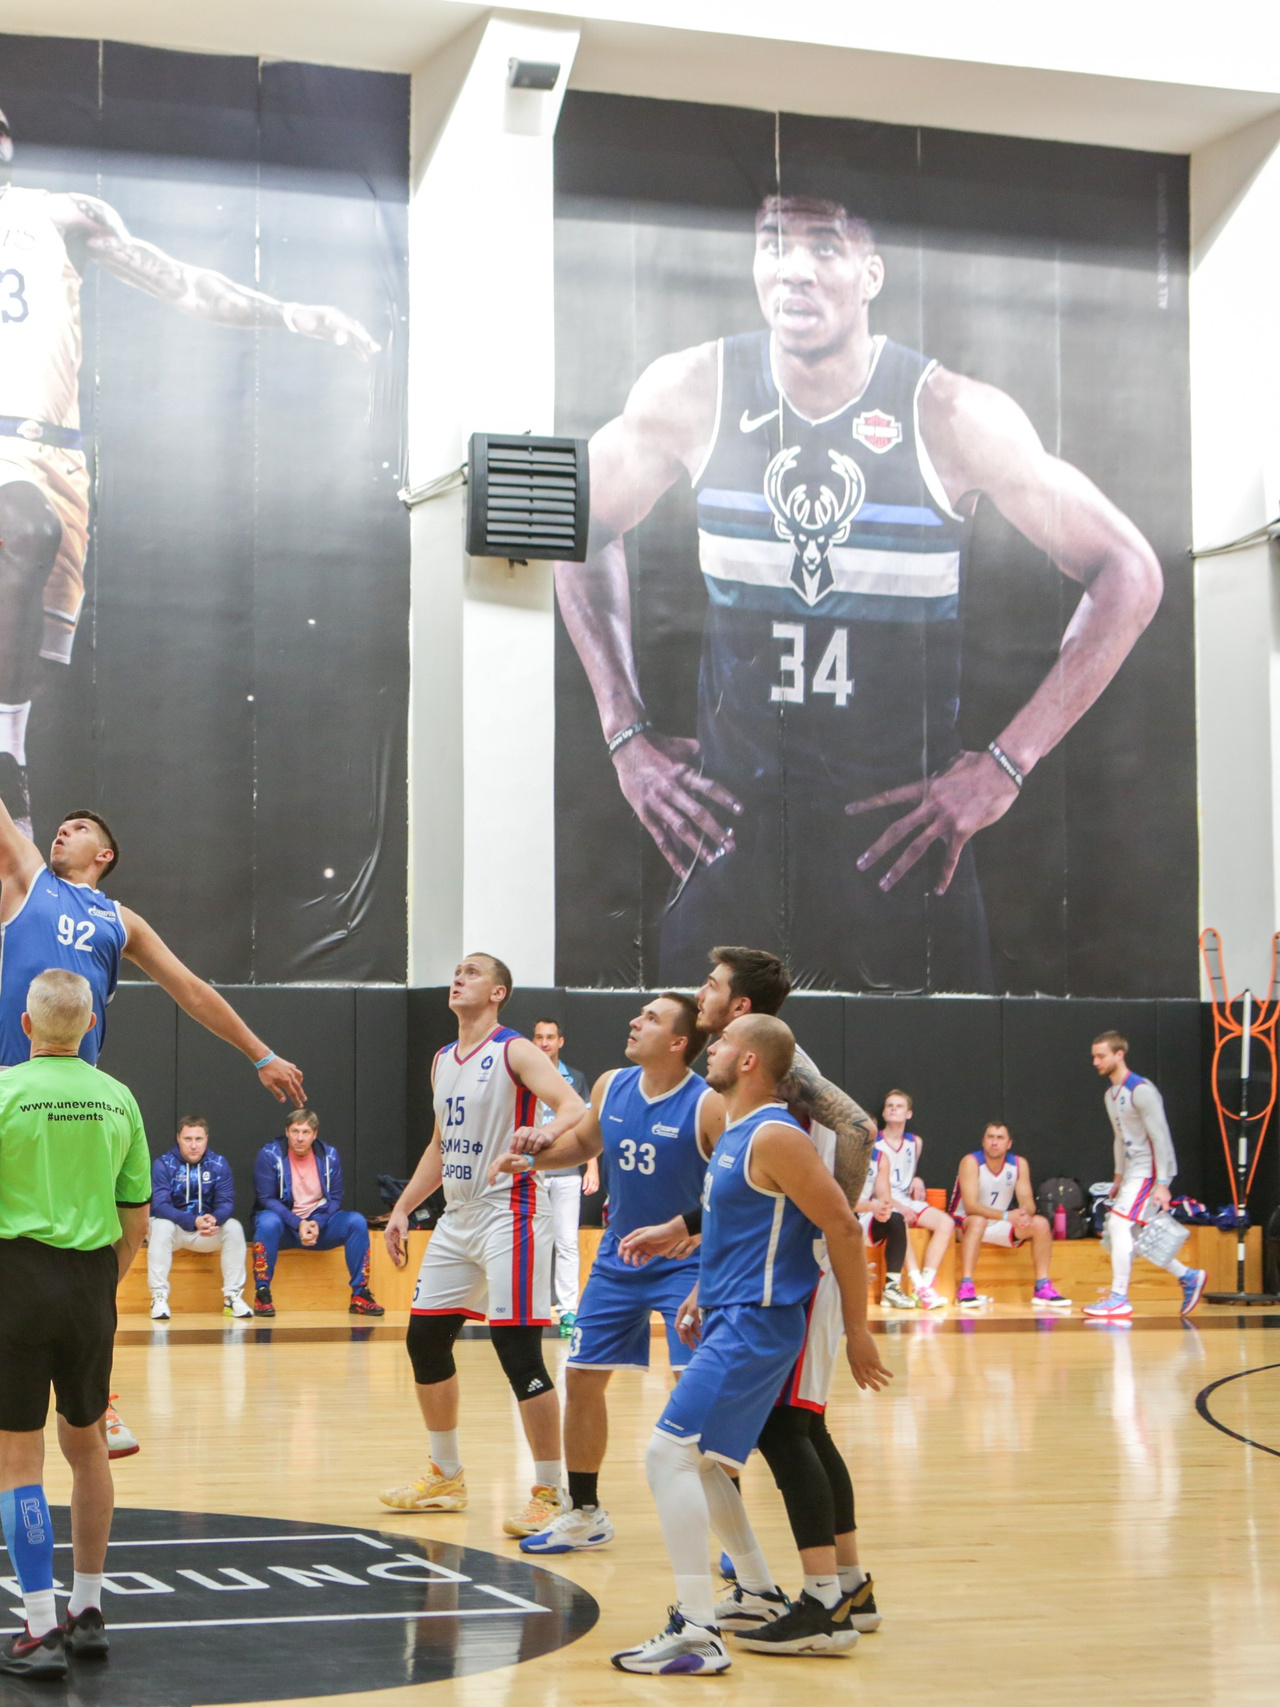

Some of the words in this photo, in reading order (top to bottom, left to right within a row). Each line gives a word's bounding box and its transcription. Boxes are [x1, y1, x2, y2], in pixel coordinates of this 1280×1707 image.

[770, 621, 854, 706] 34
[57, 914, 96, 952] 92
[19, 1100, 125, 1116] www.unevents.ru
[47, 1112, 104, 1122] #unevents
[445, 1096, 466, 1127] 15
[618, 1138, 656, 1175] 33
[990, 1191, 1000, 1207] 7
[20, 1497, 45, 1545] RUS
